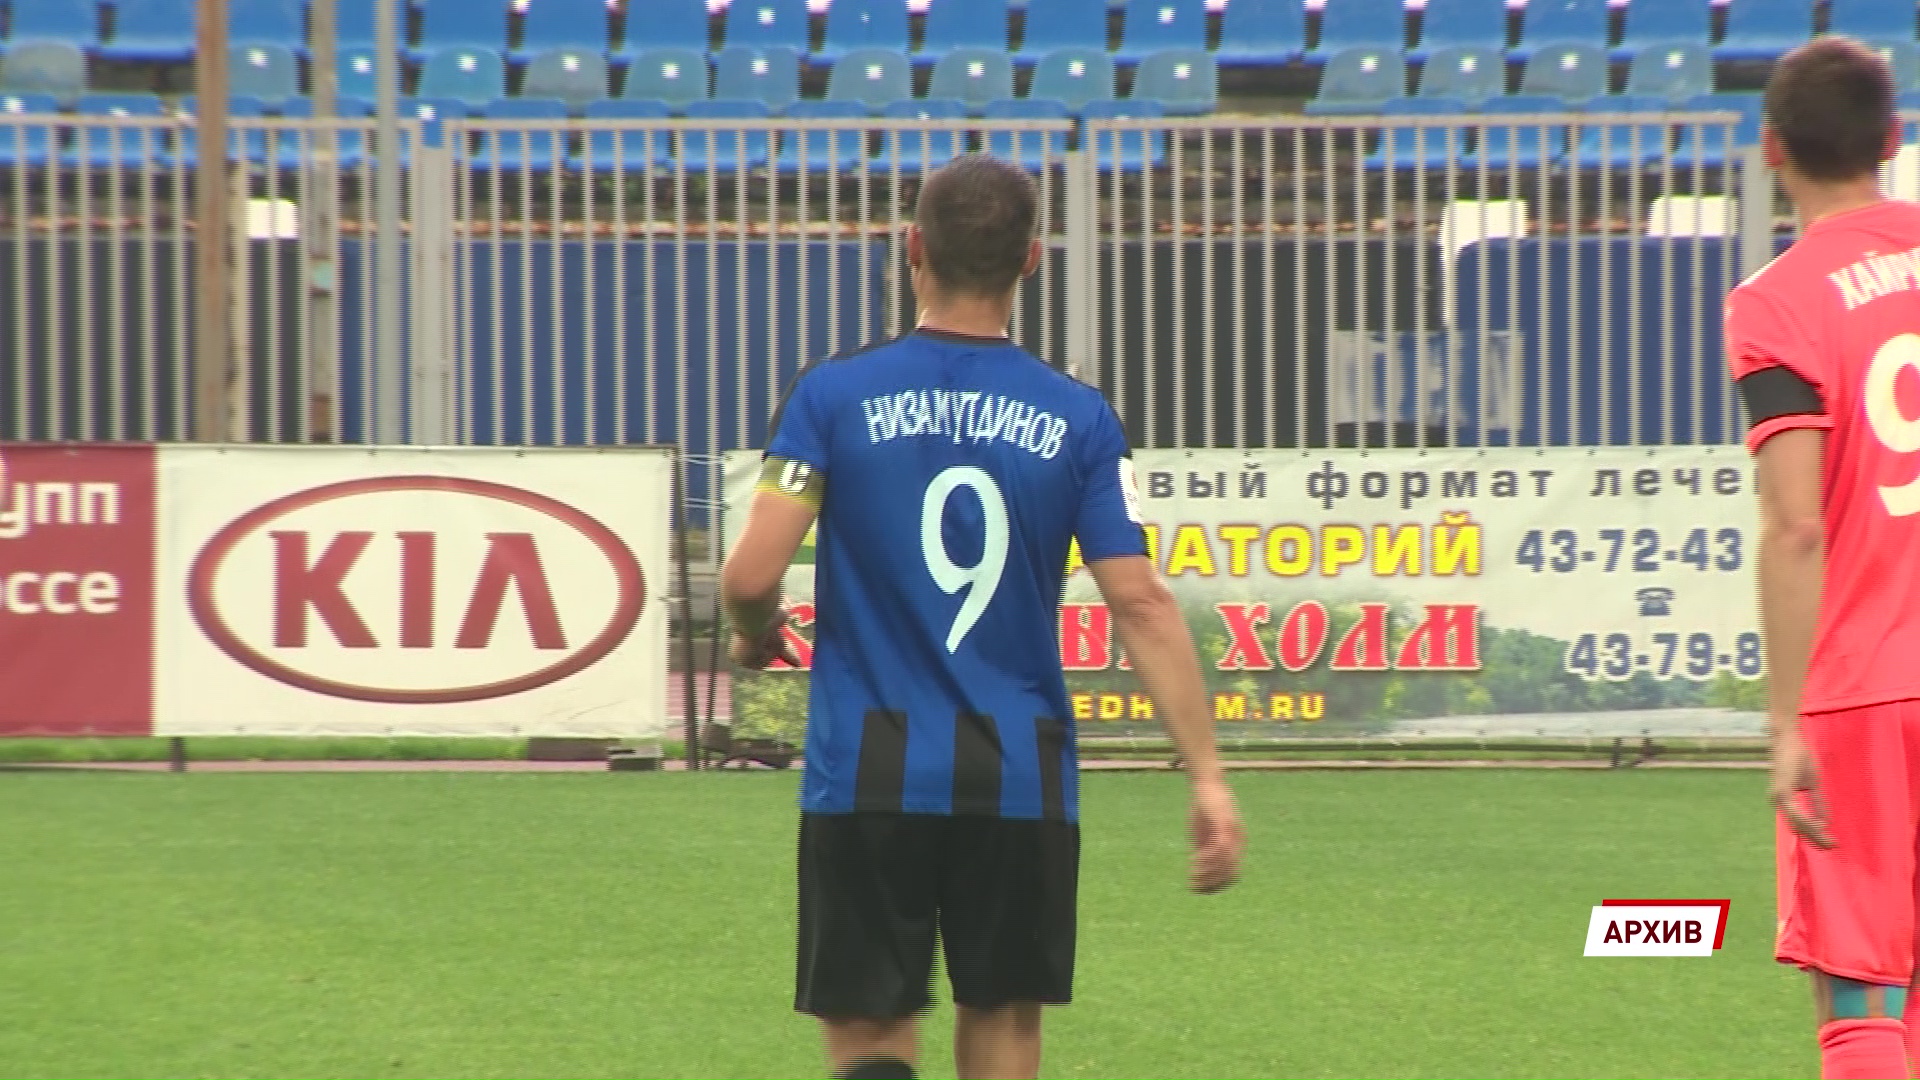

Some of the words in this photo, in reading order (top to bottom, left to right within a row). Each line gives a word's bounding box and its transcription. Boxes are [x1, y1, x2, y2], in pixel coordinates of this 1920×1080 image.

[862, 388, 1067, 460] НИЗАМУТДИНОВ
[1148, 464, 1266, 498] вый
[1307, 460, 1553, 509] формат
[1590, 467, 1760, 497] лече
[920, 466, 1010, 654] 9
[1067, 512, 1481, 576] АТОРИЙ
[1517, 528, 1742, 572] 43-72-43
[0, 571, 120, 614] ссе
[269, 531, 568, 650] KIA
[1215, 601, 1482, 671] ХОЛМ
